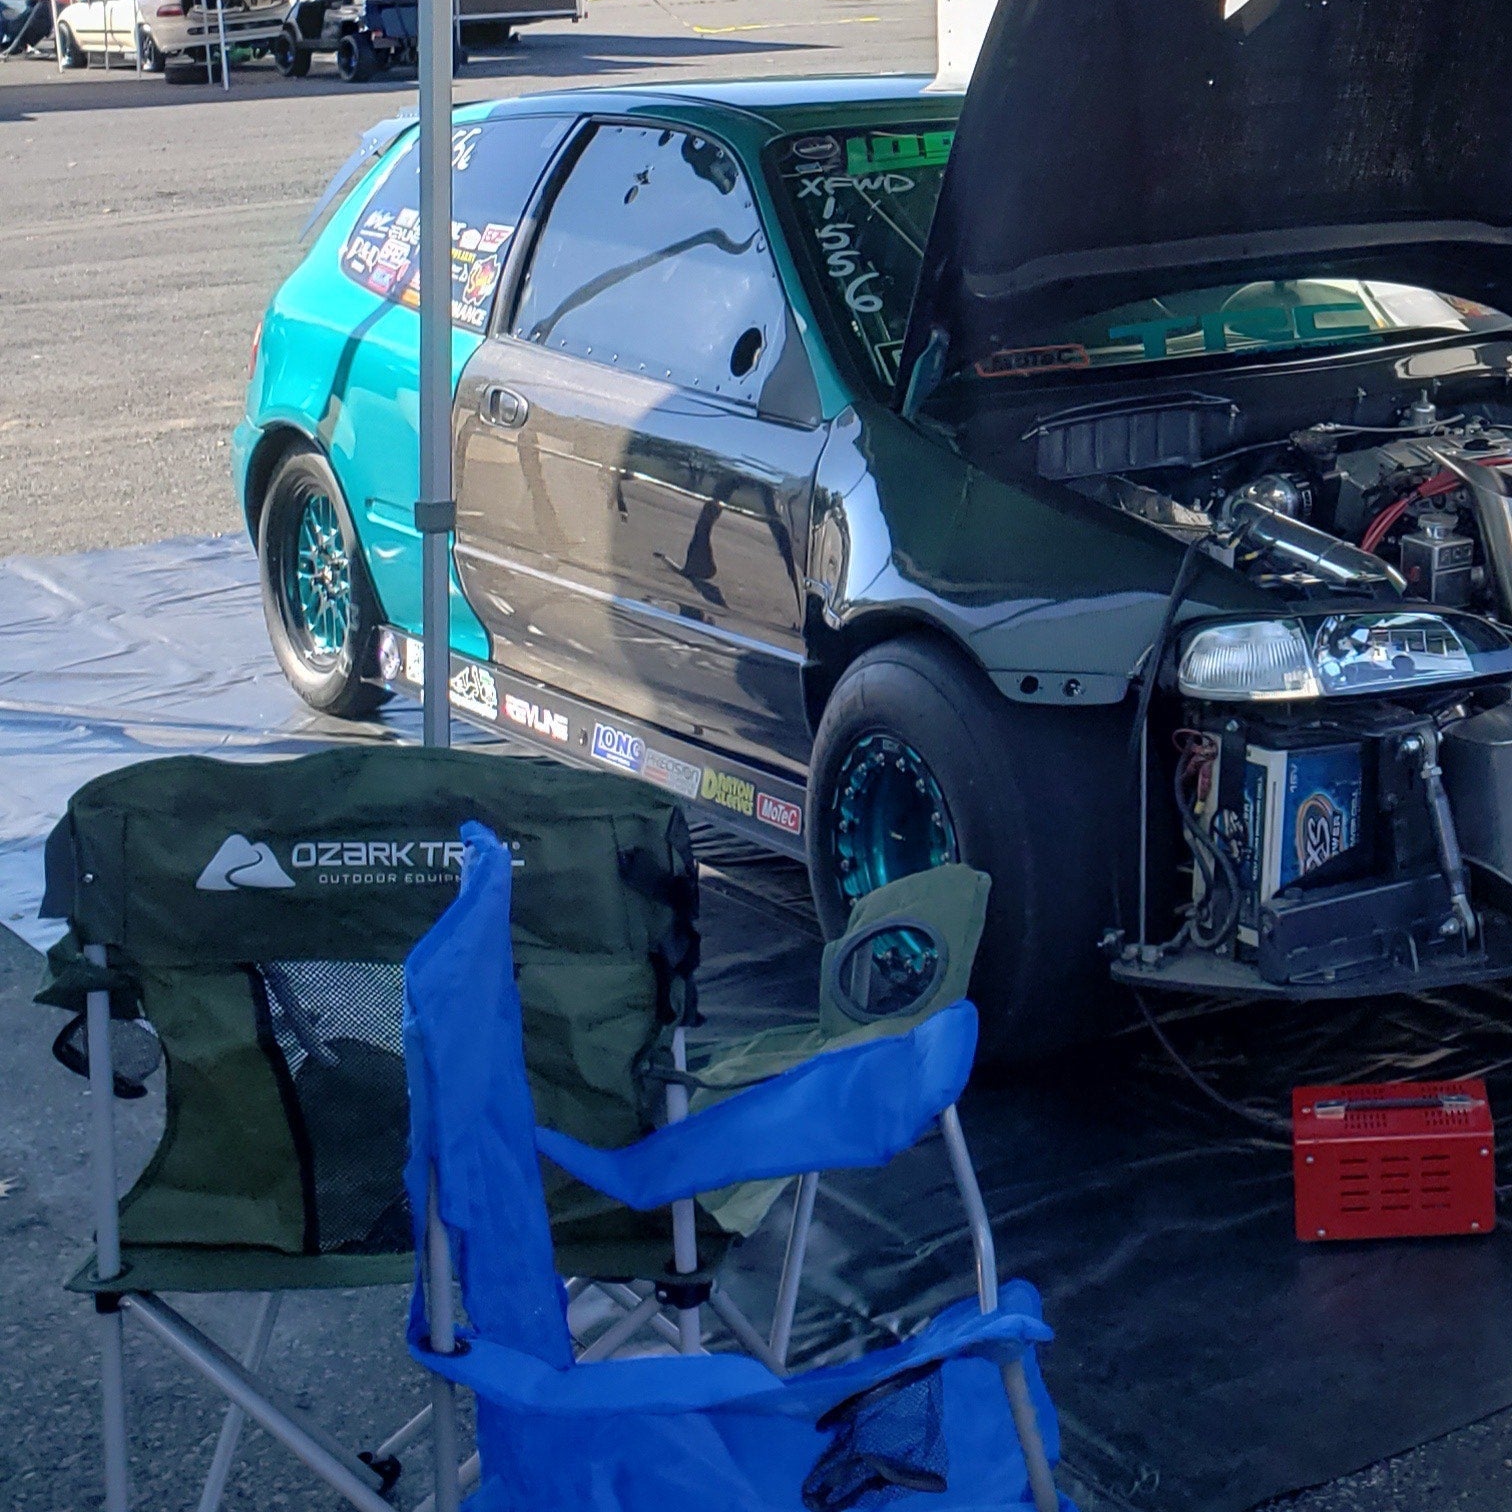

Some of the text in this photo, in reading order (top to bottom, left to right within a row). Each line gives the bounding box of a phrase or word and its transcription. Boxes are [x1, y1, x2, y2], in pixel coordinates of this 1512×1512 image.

[797, 173, 915, 199] XFWD
[761, 799, 798, 829] MoTeC
[291, 842, 414, 868] OZARK
[1306, 816, 1331, 870] XS
[318, 873, 397, 884] OUTDOOR
